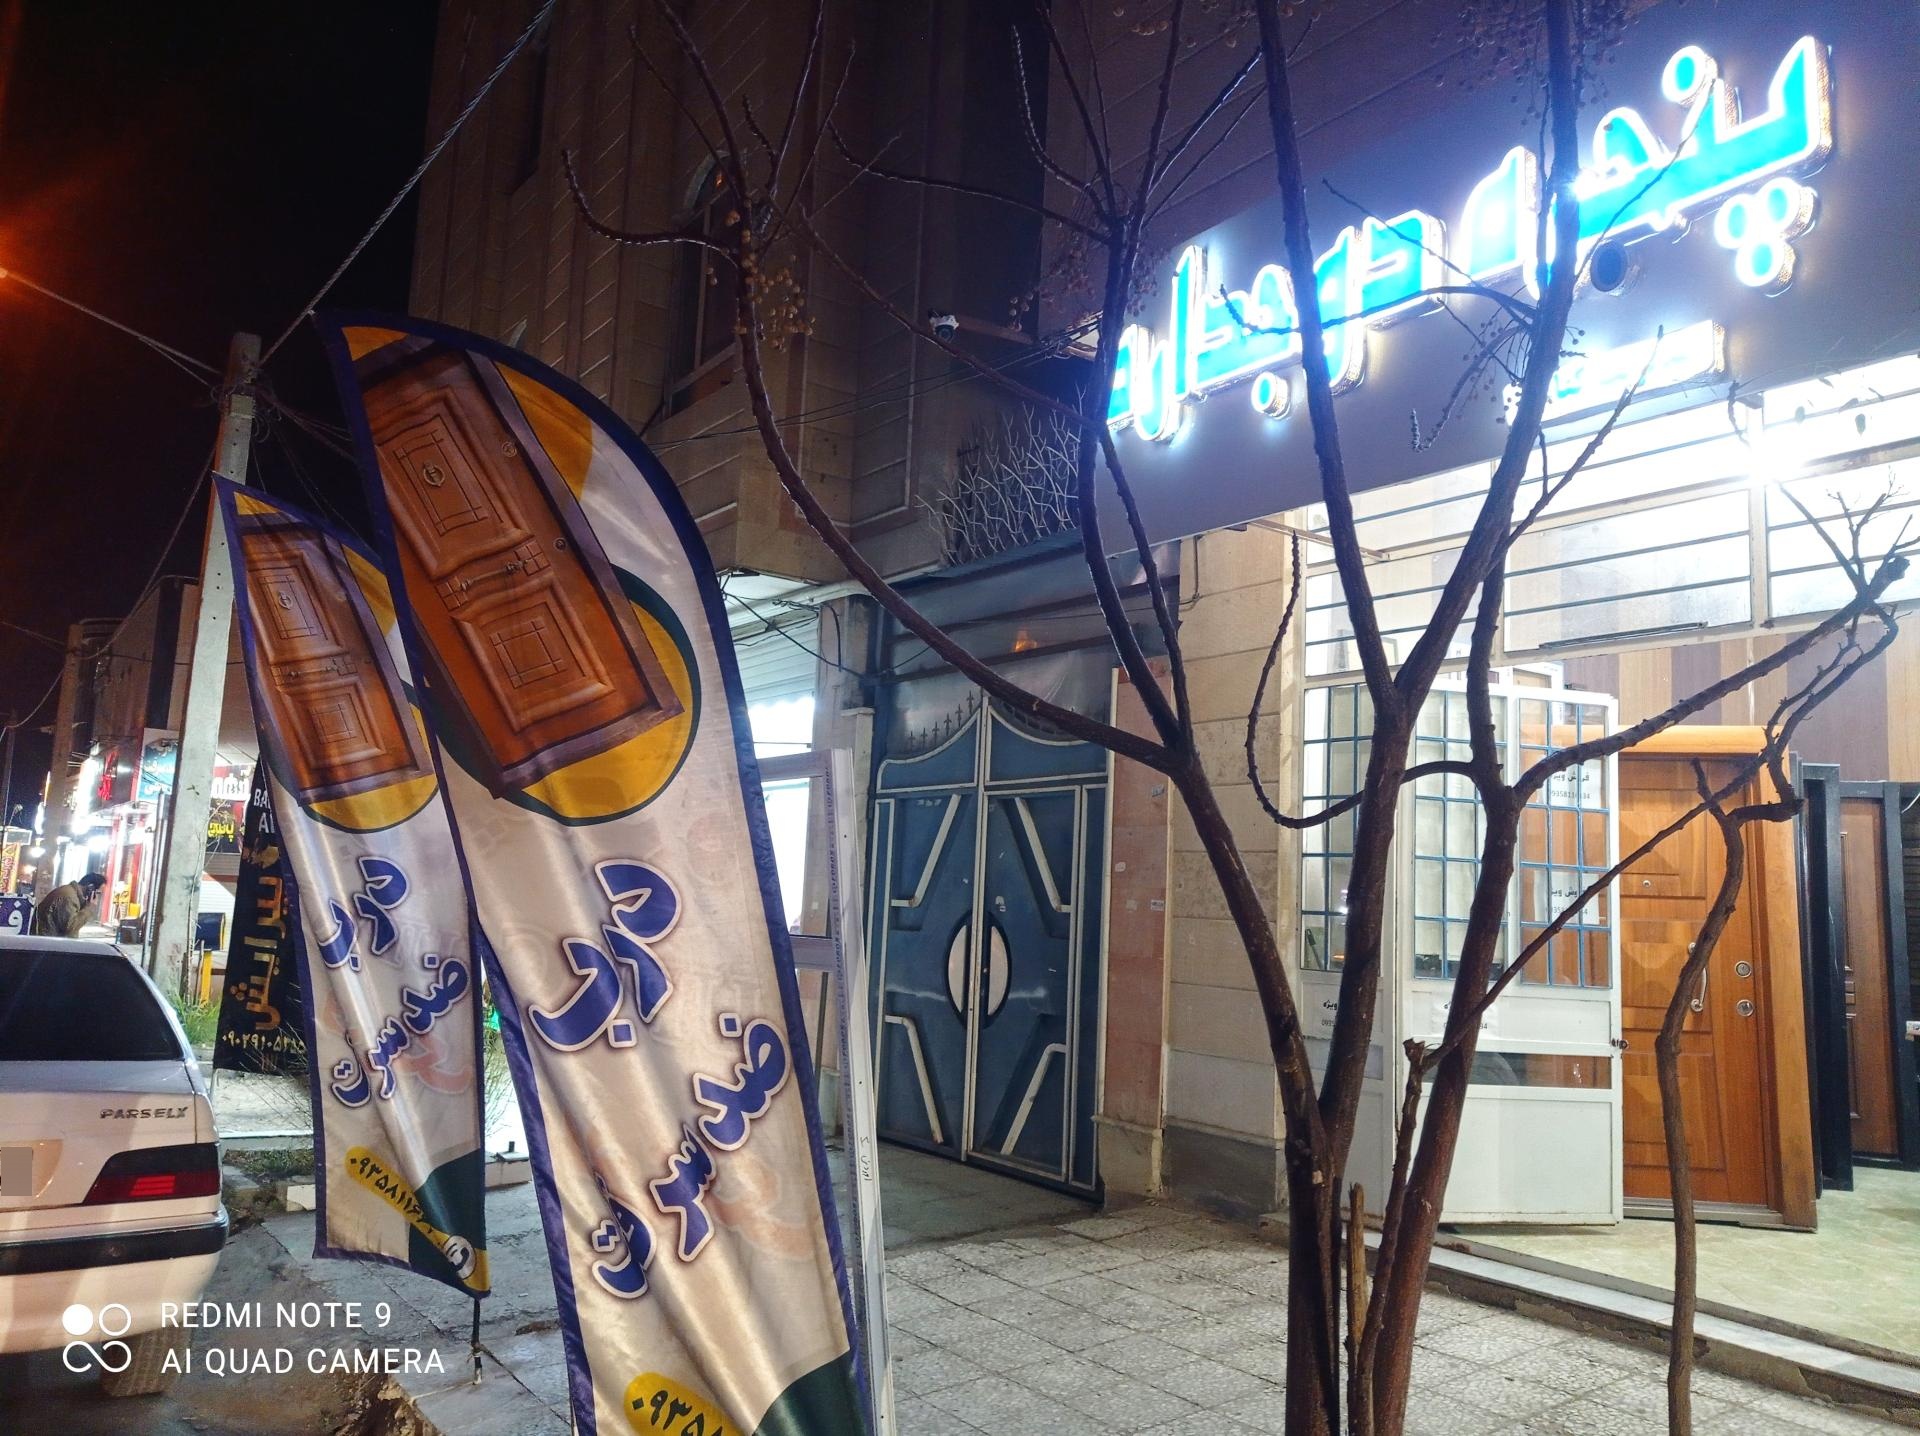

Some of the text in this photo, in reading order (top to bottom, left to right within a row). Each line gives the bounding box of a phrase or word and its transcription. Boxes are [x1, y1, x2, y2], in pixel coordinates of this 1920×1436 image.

[318, 856, 409, 971] درب
[529, 858, 681, 1052] درب
[331, 1016, 410, 1107] سرت
[631, 1389, 724, 1436] ۰۹۳۵
